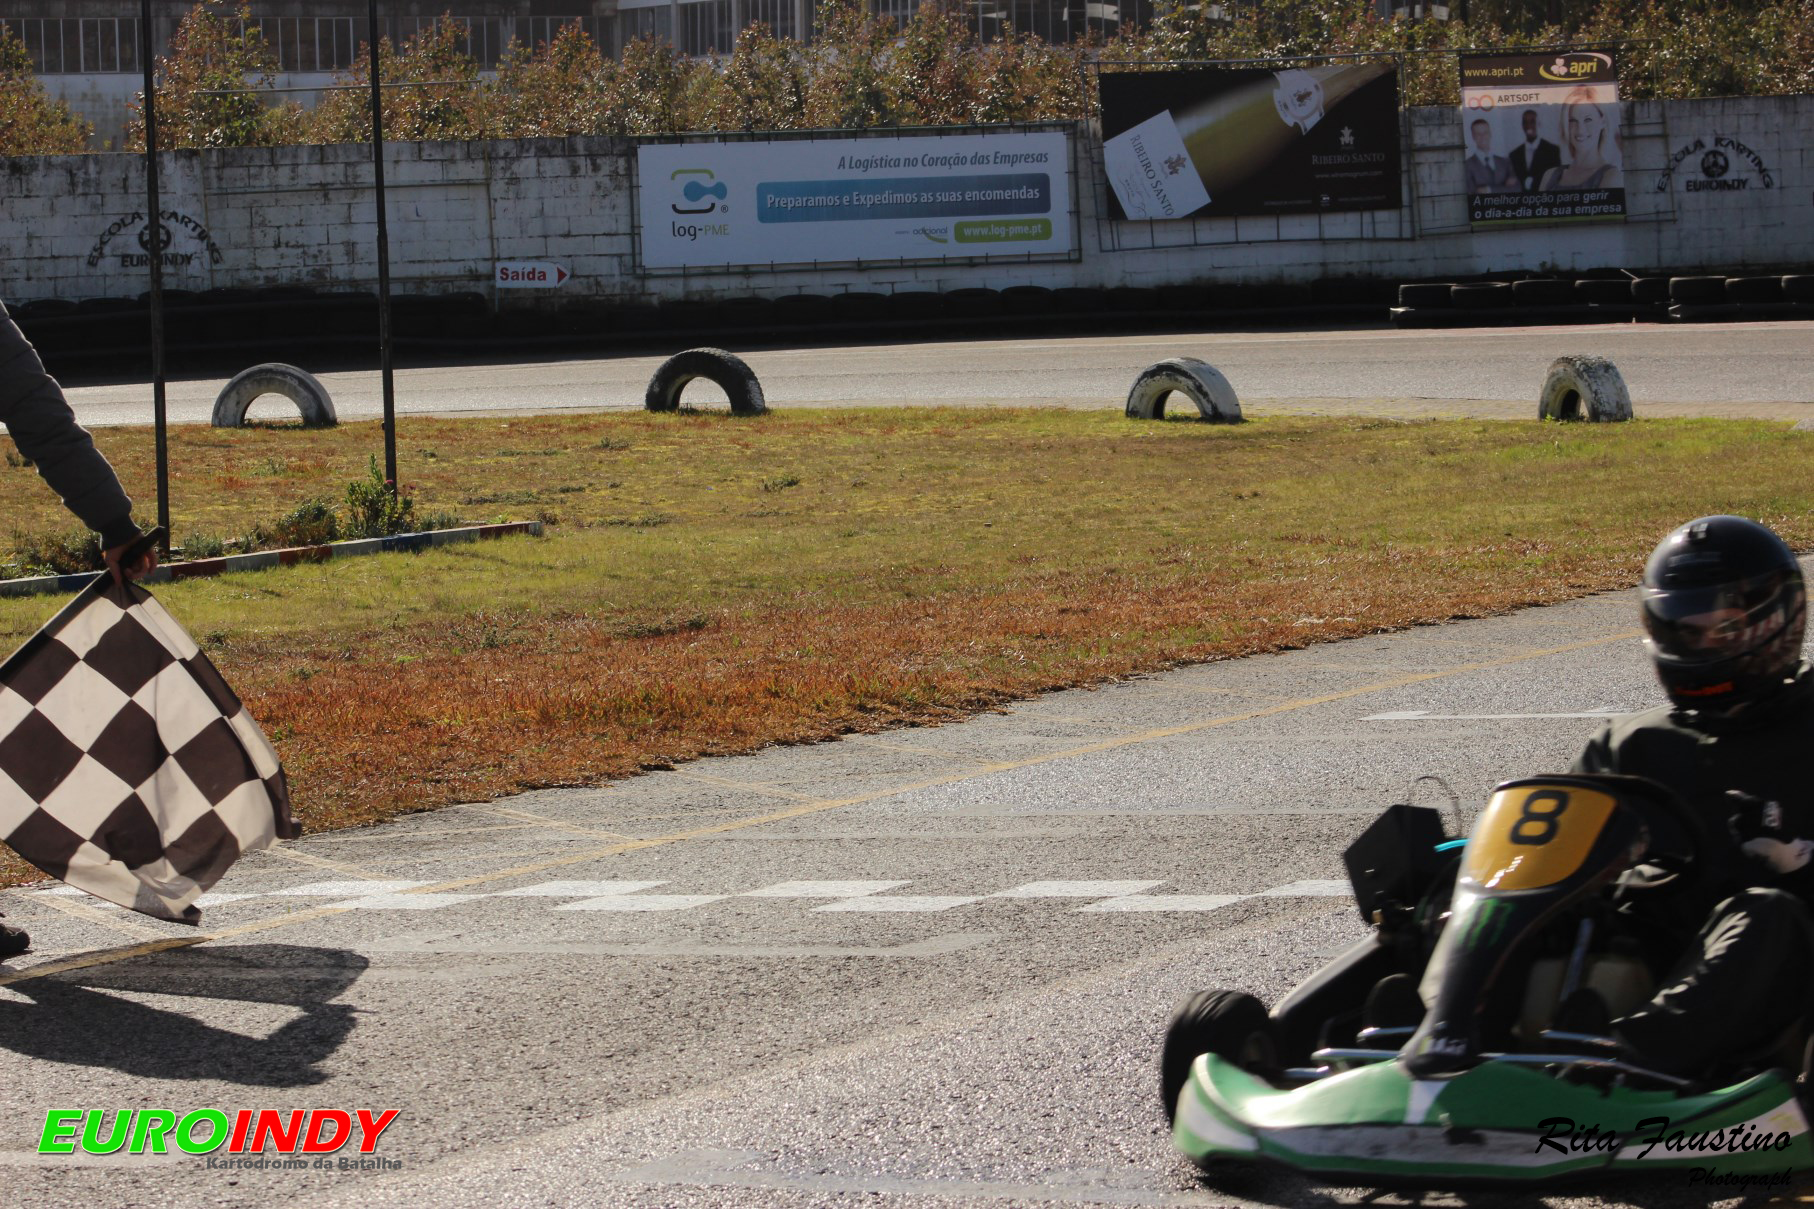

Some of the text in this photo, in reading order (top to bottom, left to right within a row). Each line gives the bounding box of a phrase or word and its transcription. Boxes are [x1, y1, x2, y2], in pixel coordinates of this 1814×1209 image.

[1464, 66, 1524, 78] www.apri.pt
[1569, 58, 1597, 77] apri
[1498, 93, 1540, 103] ARTSOFT
[837, 151, 1049, 172] A Logística no Coração das Empresas
[1311, 153, 1385, 165] RIBEIRO SANTO
[1657, 137, 1774, 192] ESOLA KARTING
[1130, 134, 1156, 180] RIBEIRO
[1151, 180, 1175, 216] SANTO
[1686, 179, 1748, 192] EUROINDY
[767, 186, 1040, 211] Preparamos e Expedimos as suas encomendas
[1473, 190, 1609, 206] A melhor opção para gerir
[1475, 203, 1622, 219] o dia-a-dia da sua empresa
[672, 221, 730, 241] log-PME
[963, 223, 1042, 238] www.log-pme.pt
[87, 211, 144, 267] ESCOLA
[121, 253, 193, 267] EURINDY
[499, 266, 547, 281] Saída
[1510, 790, 1570, 845] 8
